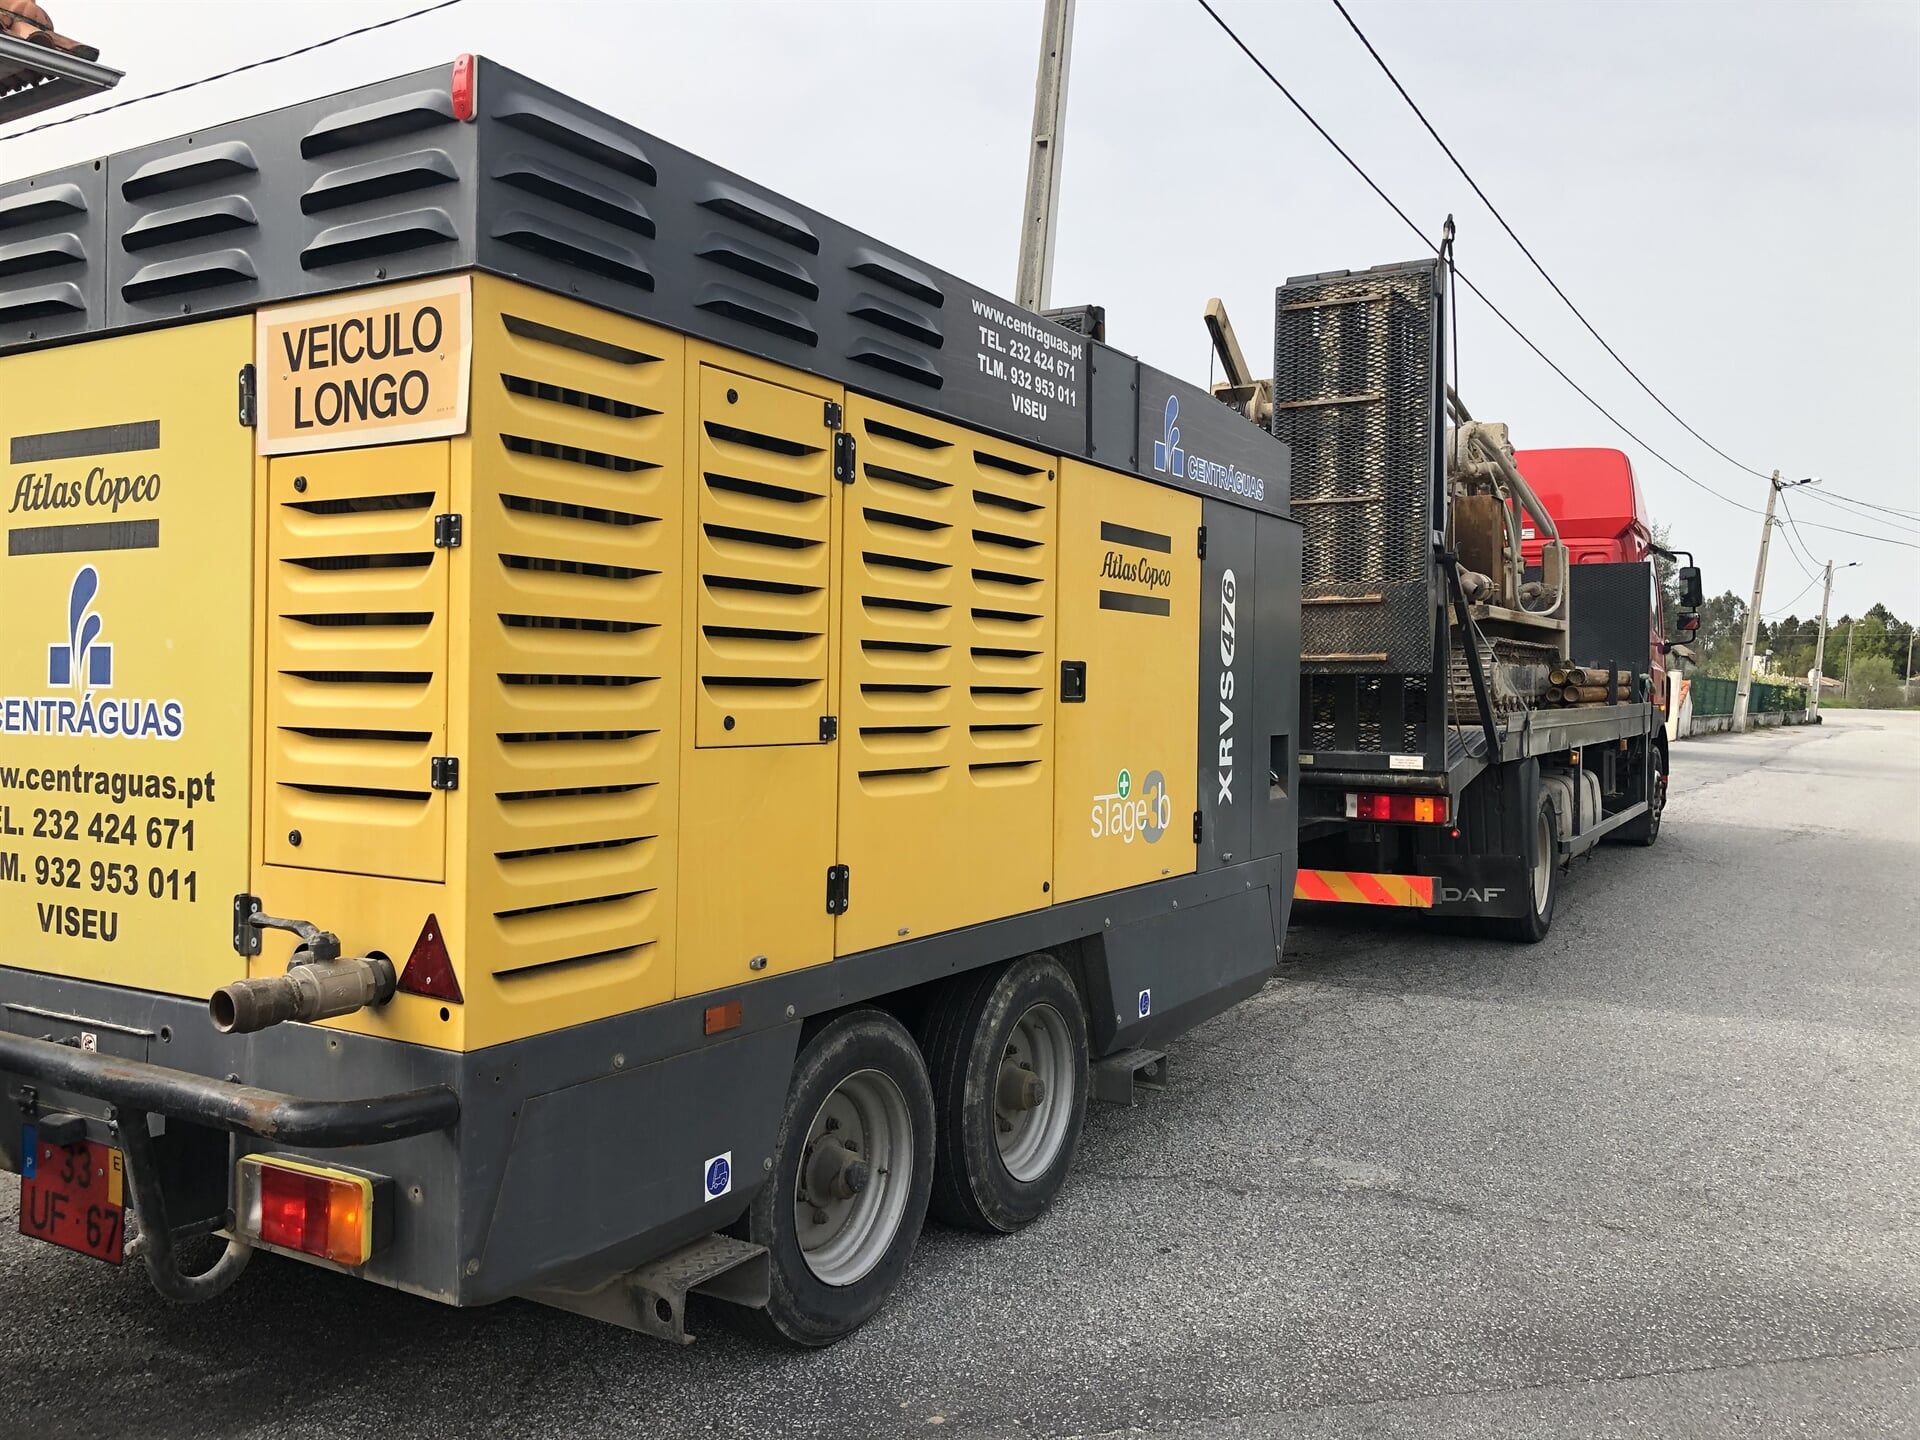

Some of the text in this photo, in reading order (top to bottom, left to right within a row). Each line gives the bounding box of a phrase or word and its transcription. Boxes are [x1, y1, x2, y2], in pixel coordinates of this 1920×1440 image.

[282, 305, 443, 372] VEICULO
[971, 298, 1082, 360] www.centraguas.pt
[979, 325, 1075, 381] TEL. 232 424 671
[294, 369, 430, 429] LONGO
[977, 352, 1076, 407] TLM. 932 953 011
[1011, 393, 1047, 421] VISEU
[8, 466, 161, 513] Atlas Copco
[1188, 455, 1264, 501] CENTRÁGUAS
[0, 693, 182, 737] ENTRÁGUAS
[32, 807, 79, 841] 232
[87, 813, 137, 846] 424
[146, 817, 195, 852] 671
[34, 855, 81, 889] 932
[89, 860, 139, 896] 953
[147, 867, 197, 902] 011
[1441, 887, 1506, 903] DAF
[37, 902, 119, 942] VISEU
[113, 1156, 121, 1171] E
